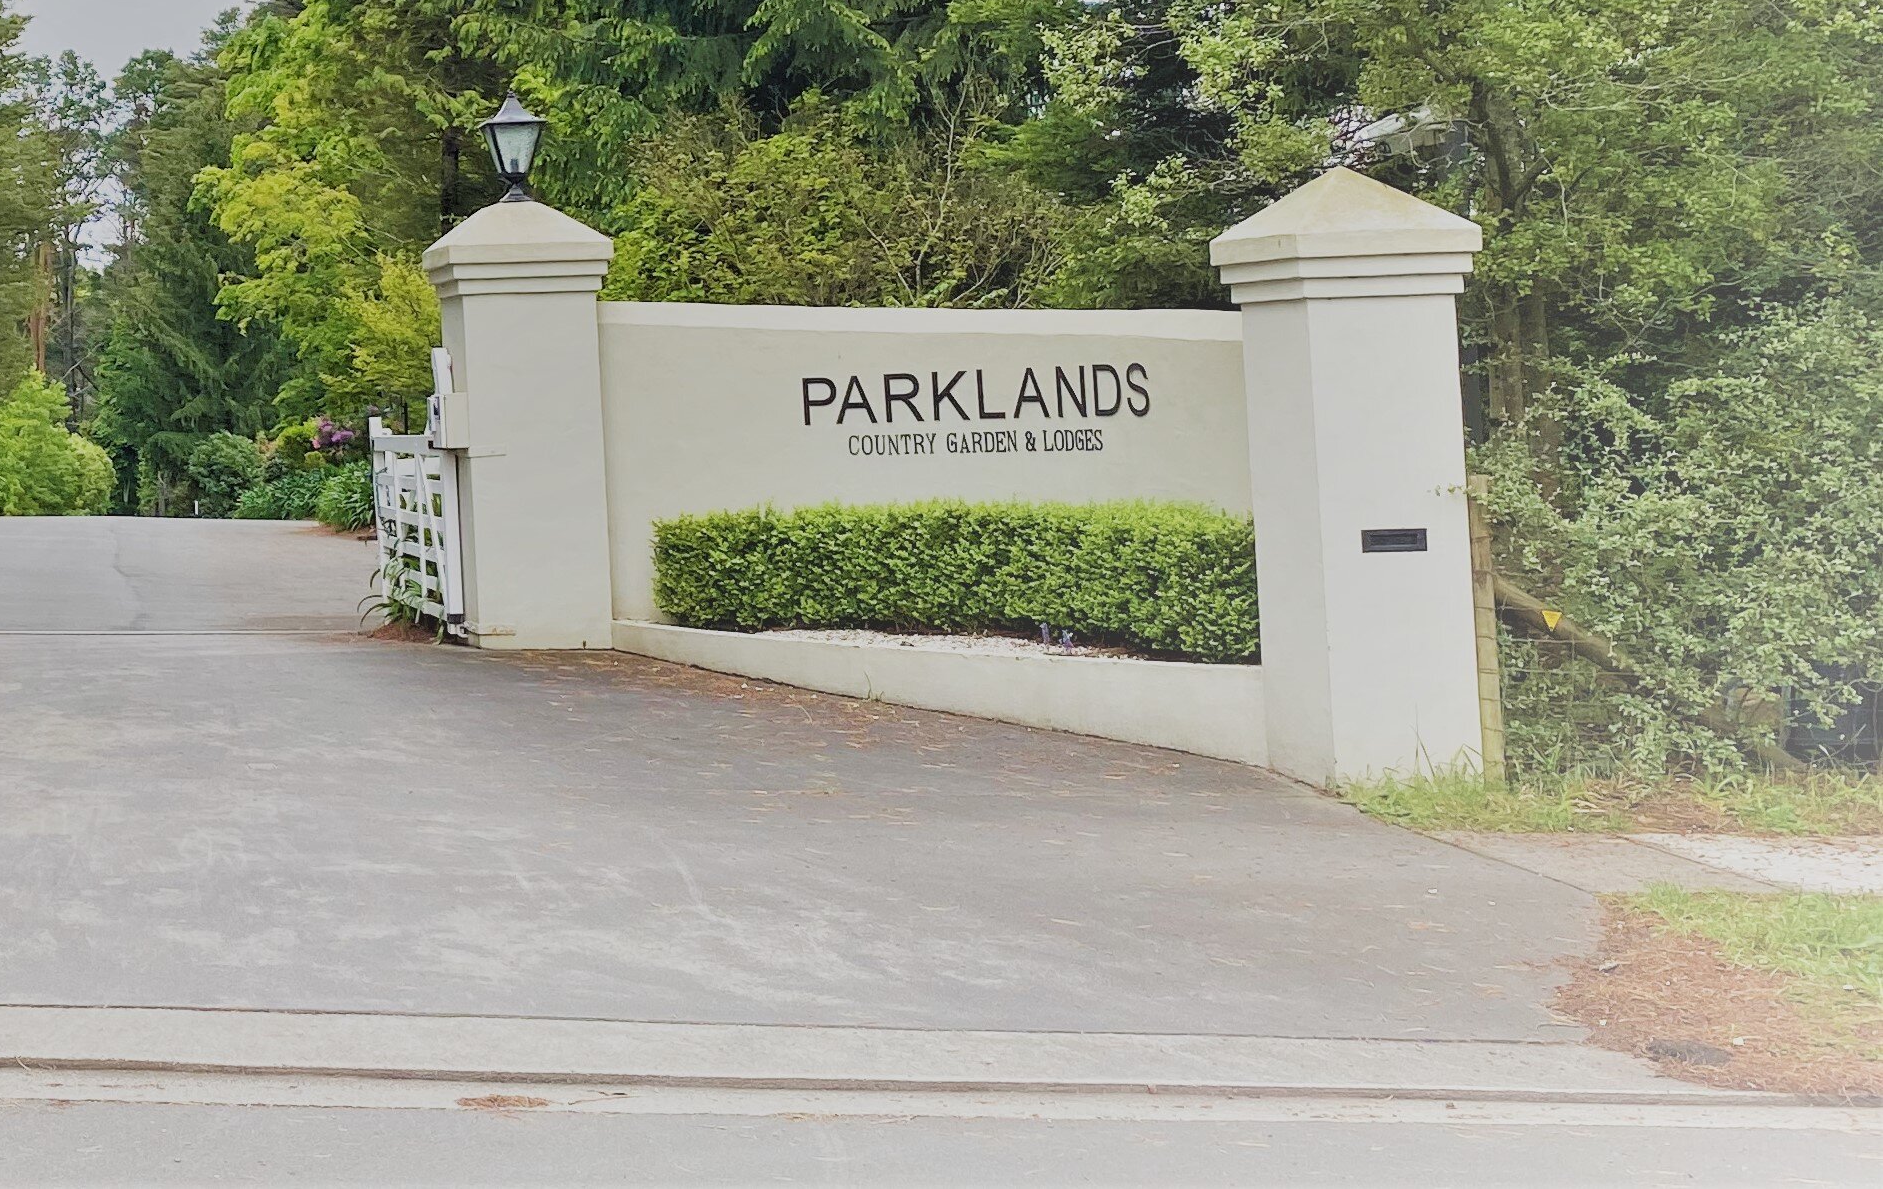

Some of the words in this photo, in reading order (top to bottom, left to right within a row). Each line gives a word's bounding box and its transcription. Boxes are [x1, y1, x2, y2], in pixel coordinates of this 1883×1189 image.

[802, 362, 1151, 426] PARKLANDS
[848, 433, 937, 456] COUNTRY
[946, 430, 1019, 454] GARDEN
[1025, 430, 1037, 452] &
[1043, 429, 1104, 452] LODGES
